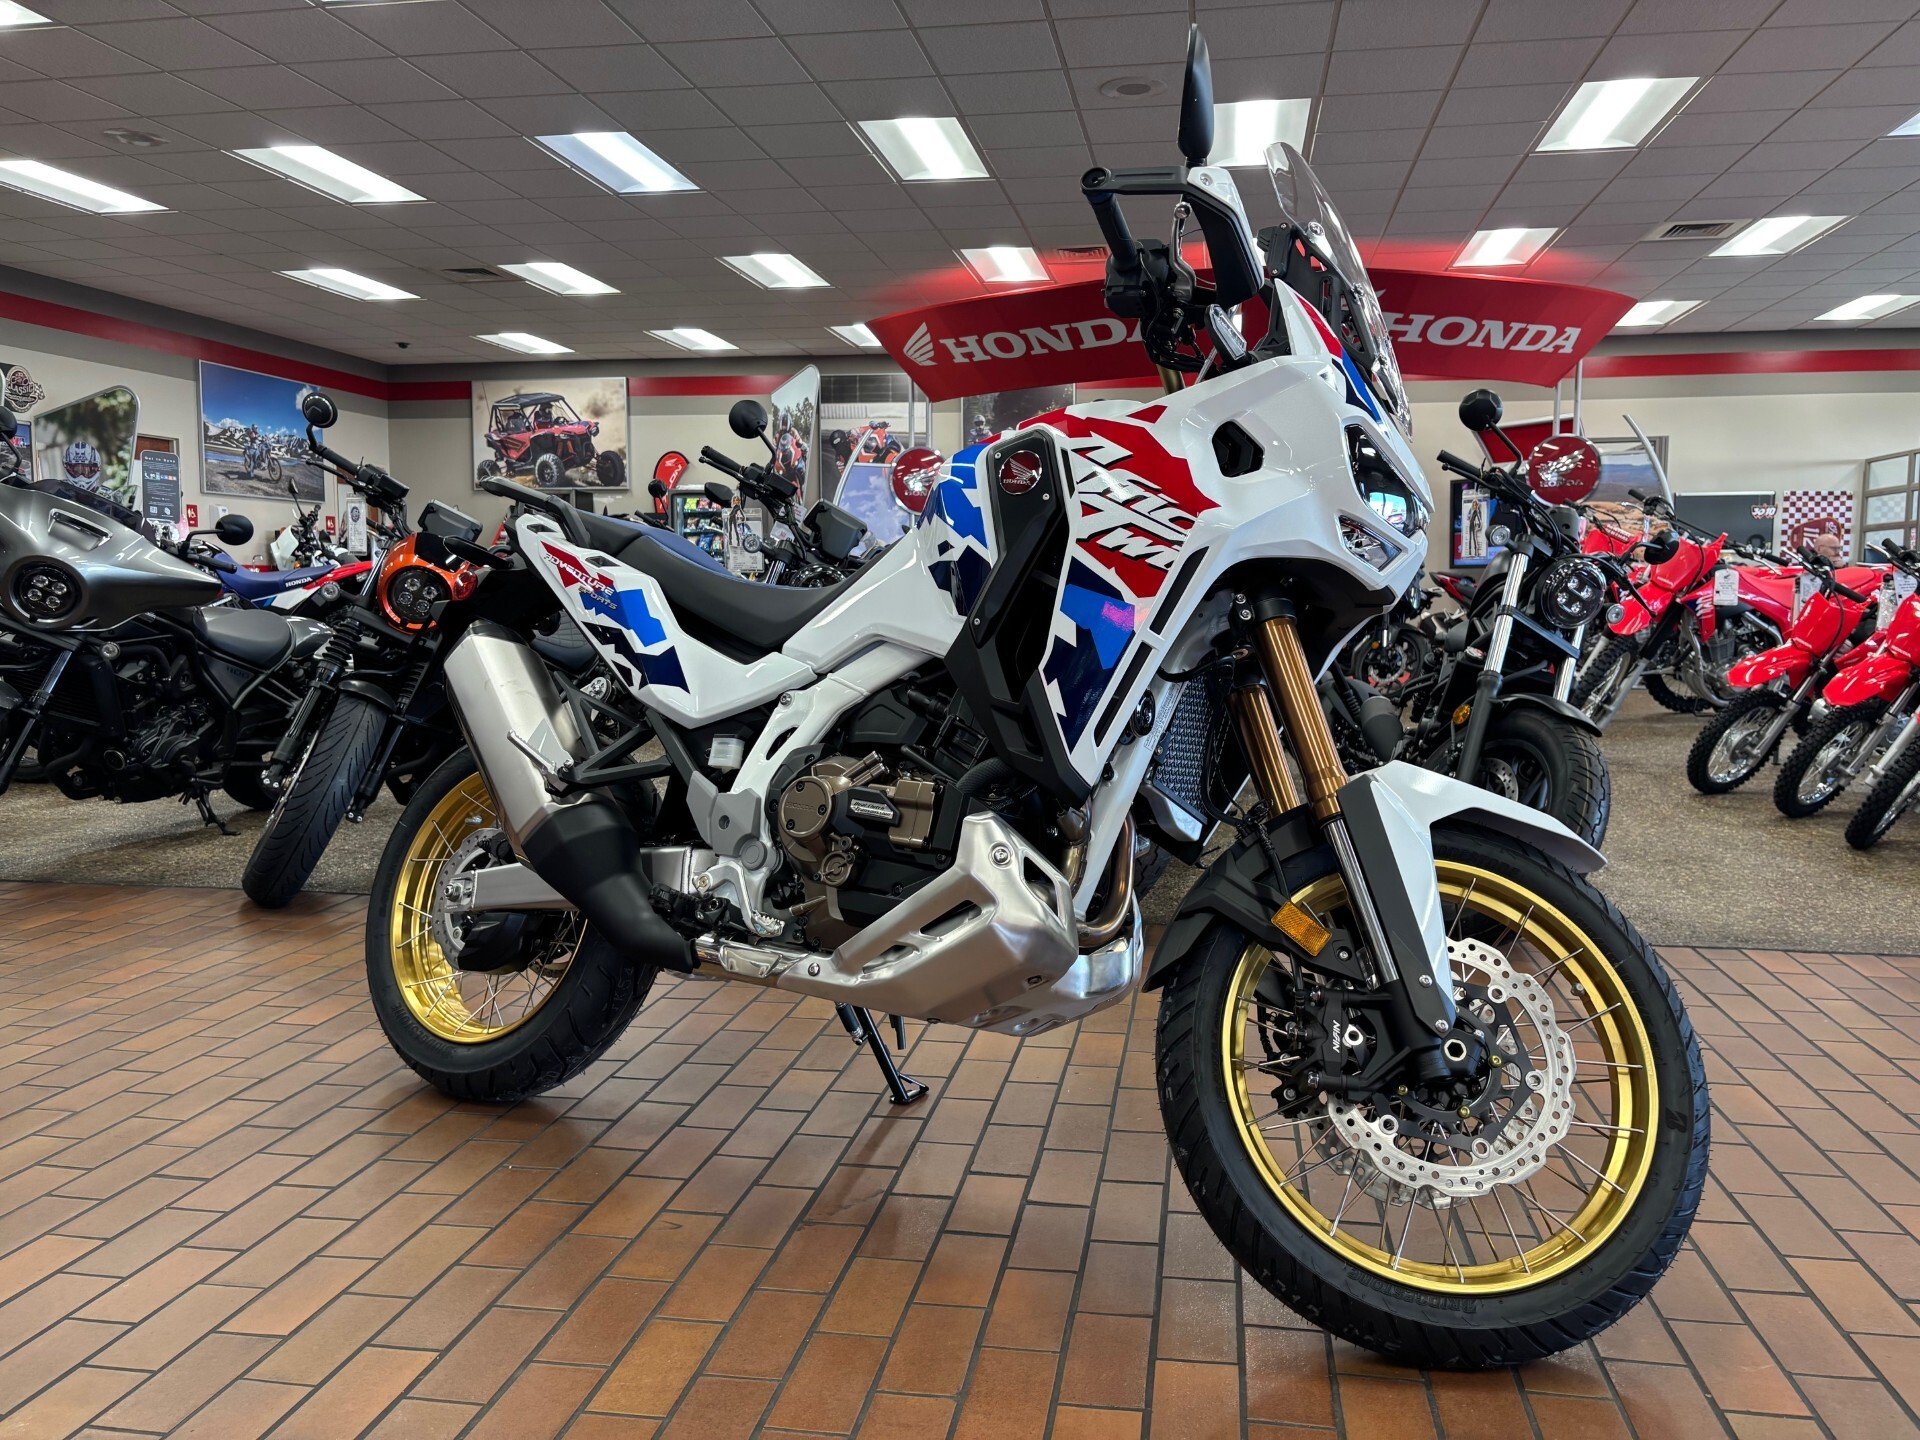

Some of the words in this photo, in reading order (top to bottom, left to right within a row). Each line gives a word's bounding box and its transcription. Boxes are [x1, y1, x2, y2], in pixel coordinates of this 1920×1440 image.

[1380, 311, 1581, 354] HONDA
[285, 576, 313, 588] HONDA
[578, 586, 618, 610] SPORTS
